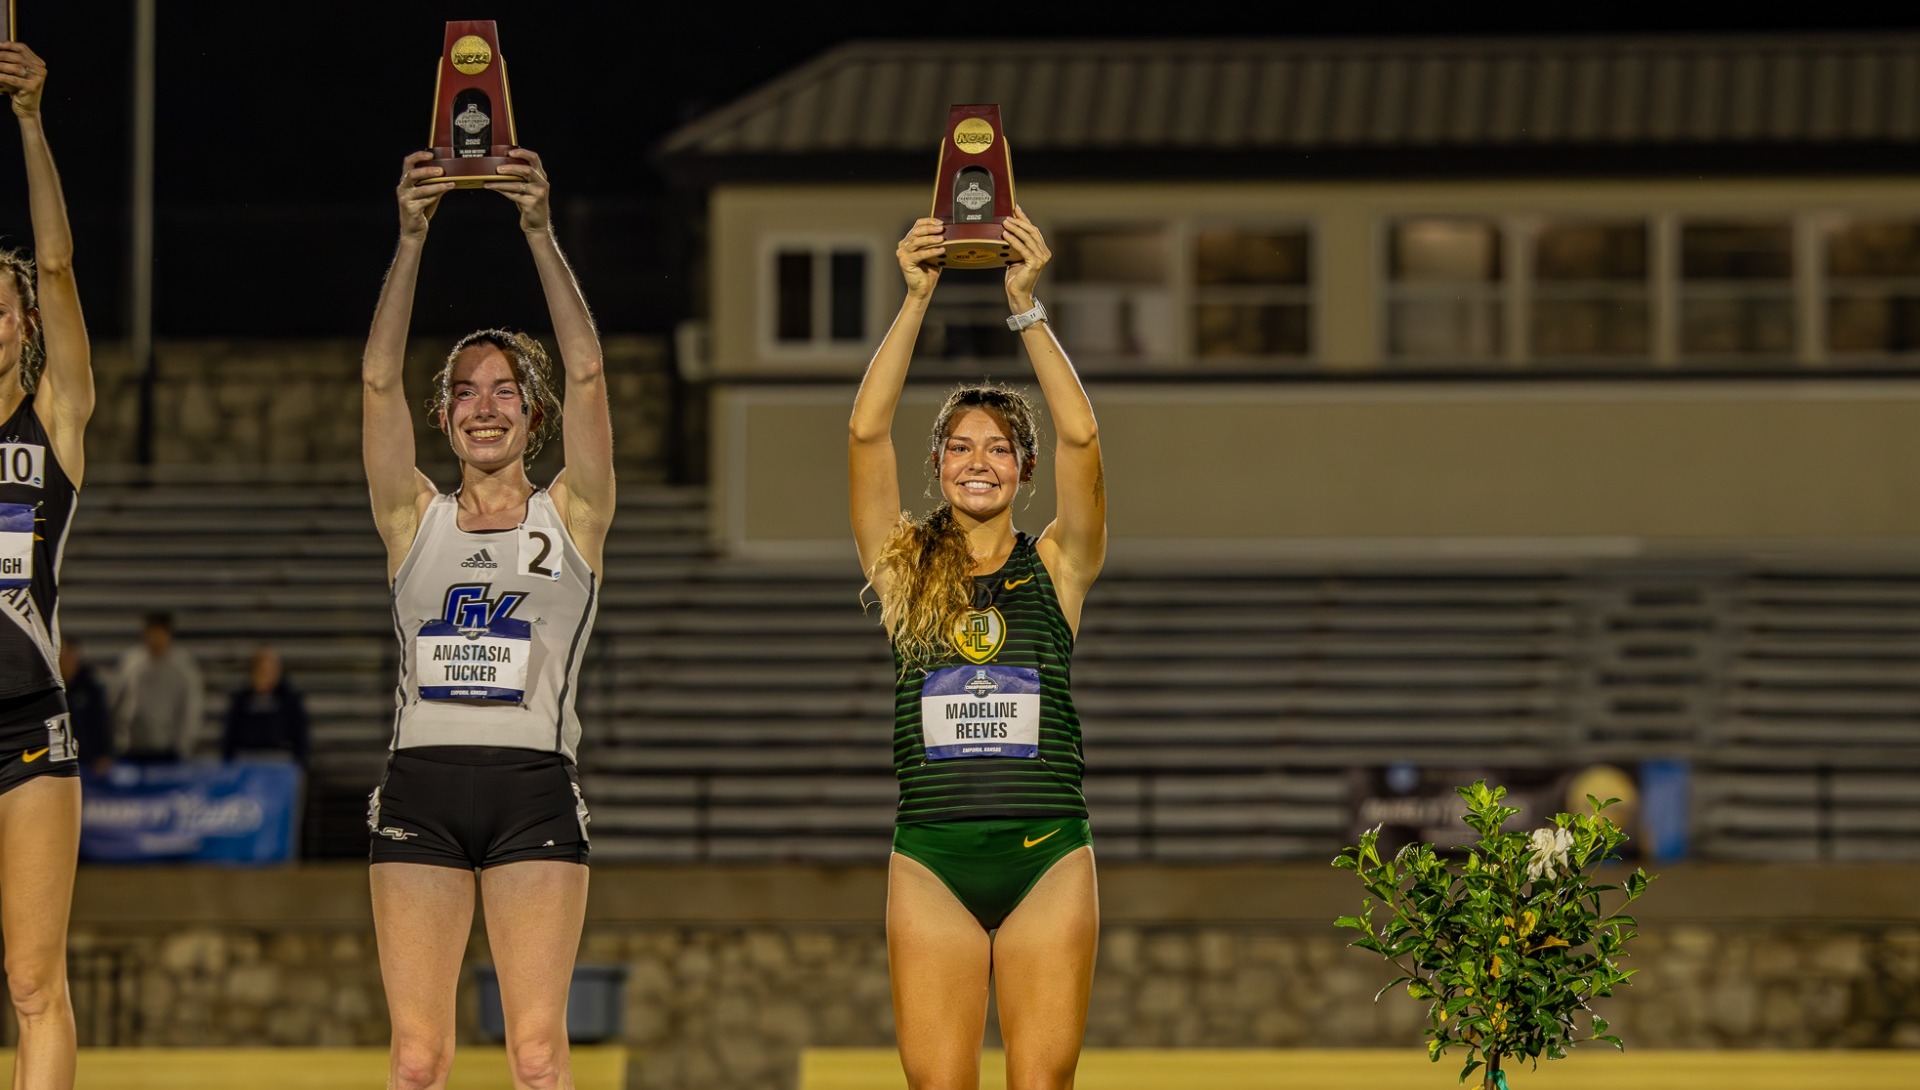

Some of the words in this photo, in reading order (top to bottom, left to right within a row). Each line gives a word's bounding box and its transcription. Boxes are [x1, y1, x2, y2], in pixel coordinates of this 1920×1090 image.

[454, 53, 490, 65] NCAA
[957, 133, 992, 144] NCAA
[0, 447, 33, 482] 10
[528, 531, 553, 578] 2
[0, 558, 22, 574] GH
[460, 560, 498, 569] adidas
[433, 644, 511, 663] ANASTASIA
[444, 664, 497, 682] TUCKER
[945, 702, 1018, 720] MADELINE
[956, 722, 1008, 739] REEVES
